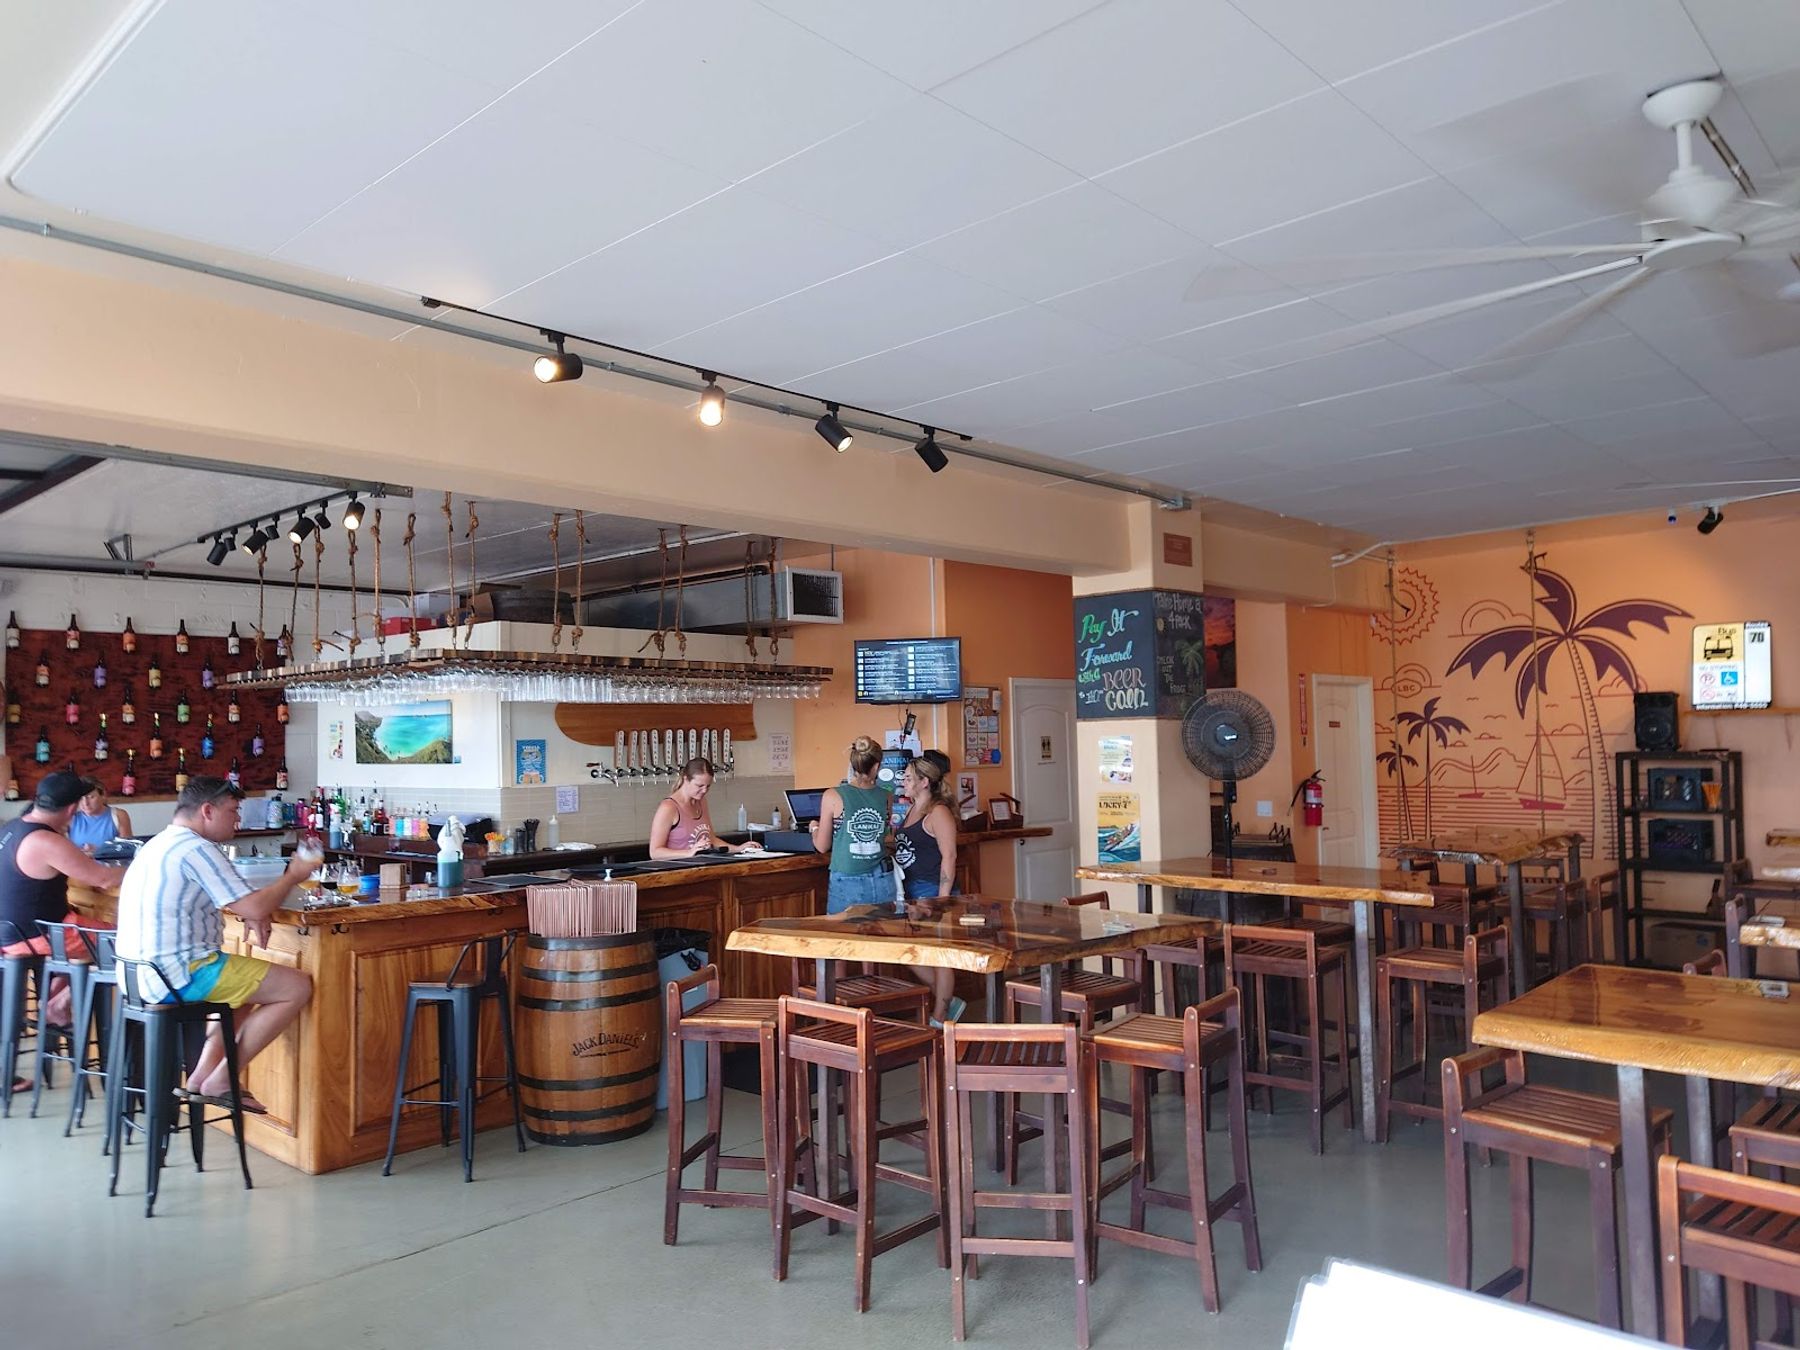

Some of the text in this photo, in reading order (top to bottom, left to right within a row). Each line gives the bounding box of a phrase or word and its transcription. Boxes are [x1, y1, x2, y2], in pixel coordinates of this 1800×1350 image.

[1079, 608, 1139, 643] Pay It
[1080, 641, 1132, 671] Forward
[572, 1037, 598, 1056] JACK
